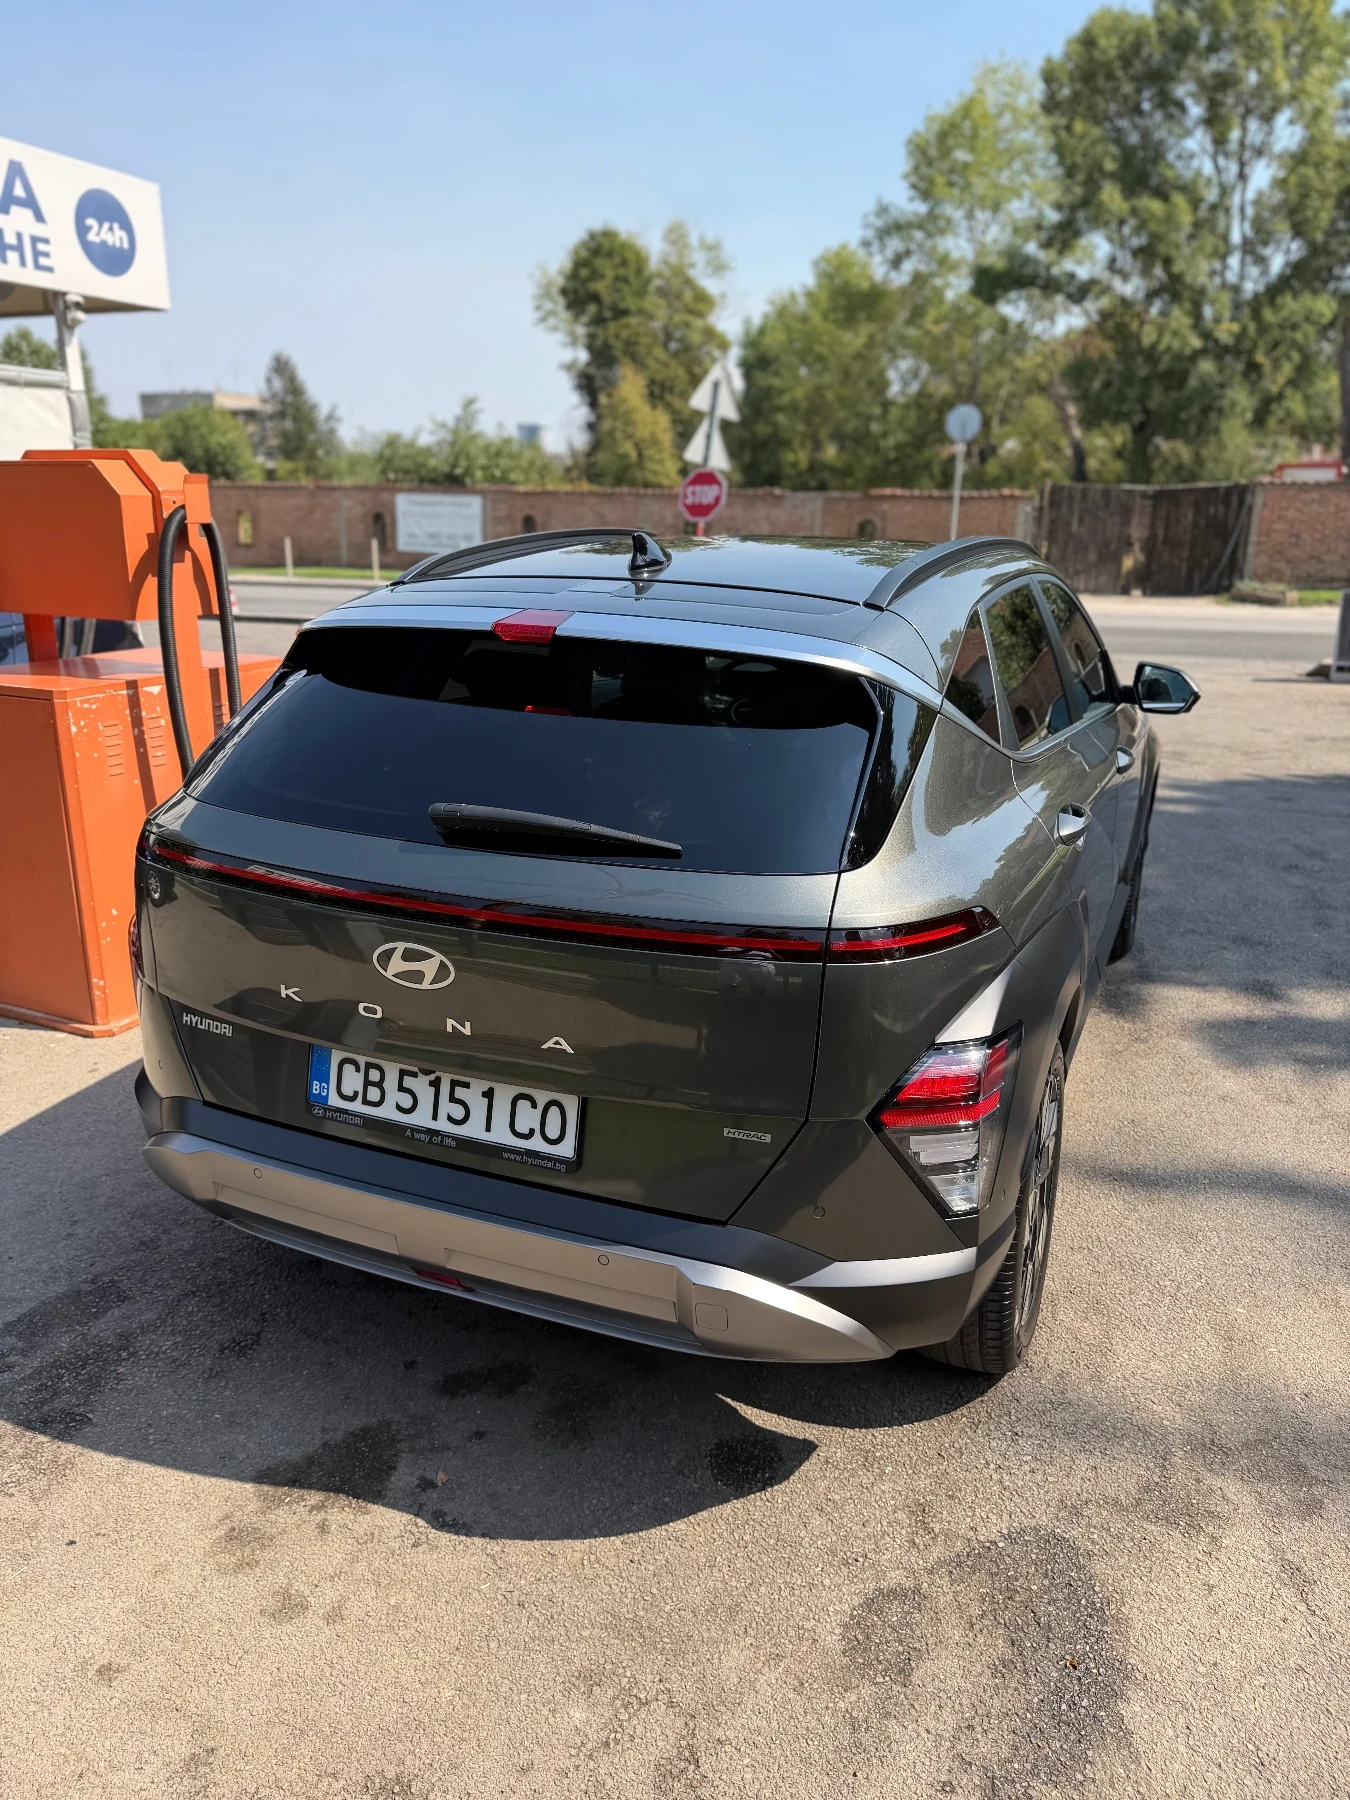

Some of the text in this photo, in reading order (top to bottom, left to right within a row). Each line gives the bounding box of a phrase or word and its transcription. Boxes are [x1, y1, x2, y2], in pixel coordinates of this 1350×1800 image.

[84, 217, 129, 250] 24h
[685, 485, 720, 505] STOP
[182, 1012, 233, 1037] HYUNDAI
[312, 1080, 328, 1096] BG
[326, 1110, 363, 1126] HYUNDAI
[405, 1128, 456, 1147] A way of life
[726, 1129, 768, 1141] HTRAC
[502, 1151, 567, 1172] www.hyundai.bg
